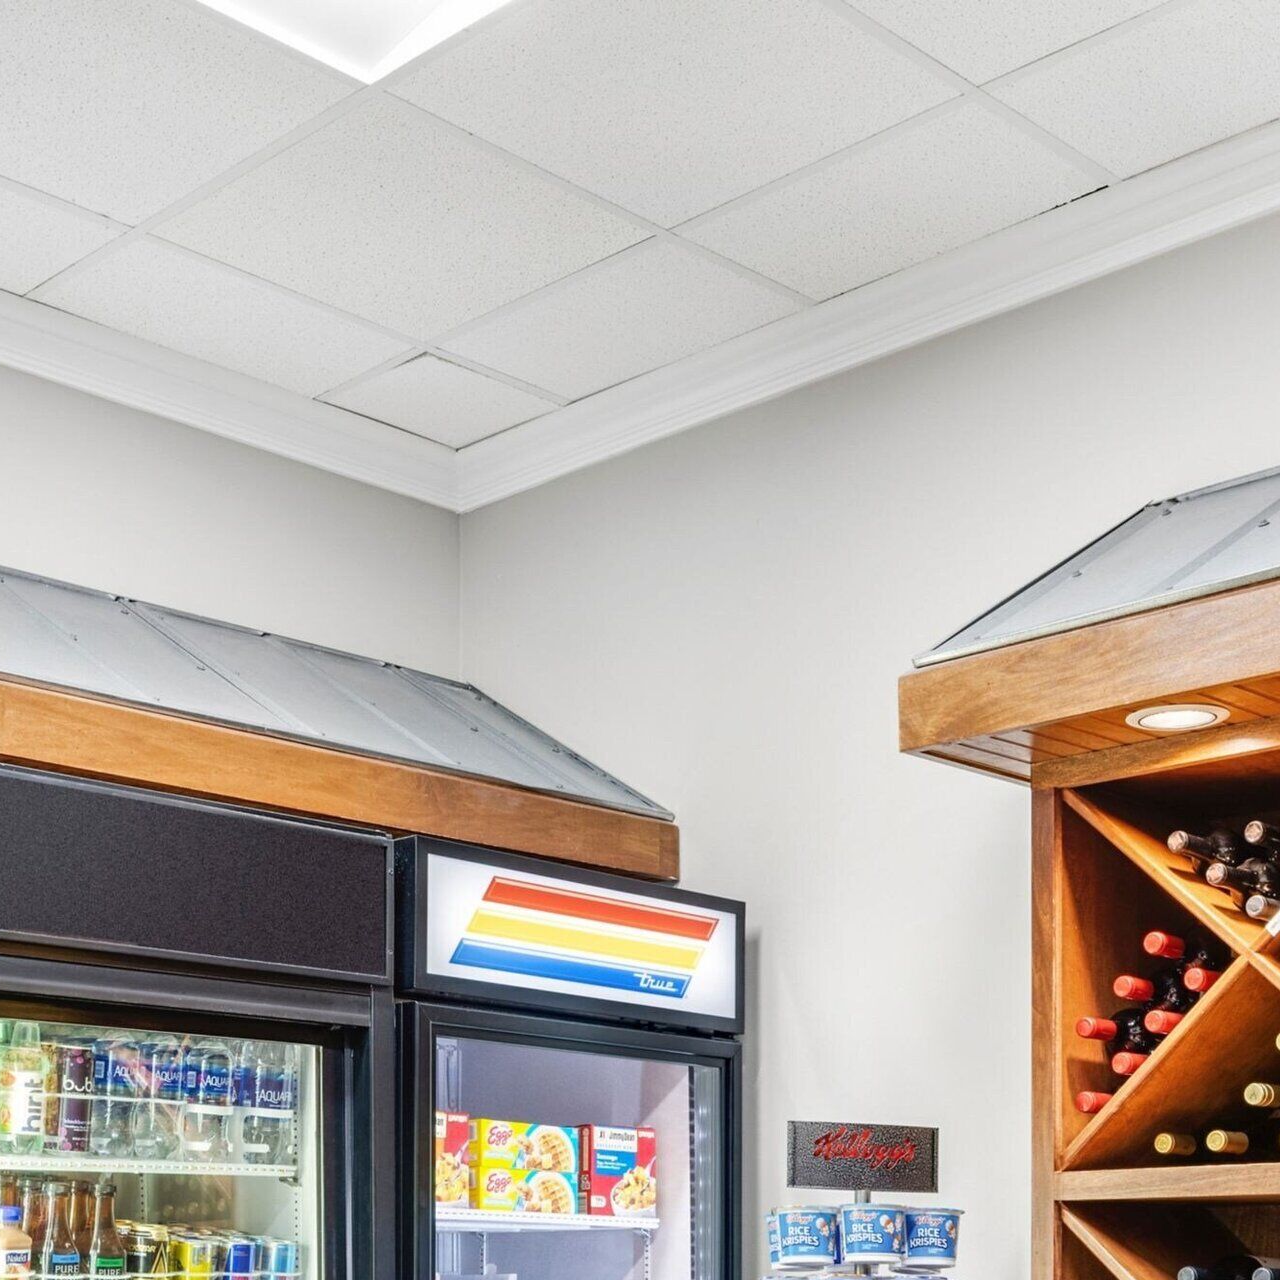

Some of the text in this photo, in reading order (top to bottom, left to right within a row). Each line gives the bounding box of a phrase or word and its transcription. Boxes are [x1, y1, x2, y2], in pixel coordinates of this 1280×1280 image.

[633, 972, 679, 993] true
[22, 1078, 43, 1132] hint
[488, 1126, 513, 1146] Eggo
[813, 1125, 918, 1170] Kellogg's
[486, 1173, 512, 1193] Eggo
[788, 1226, 810, 1236] RICE
[851, 1224, 873, 1233] RICE
[917, 1227, 939, 1237] RICE
[782, 1236, 819, 1247] KRISPIES
[847, 1233, 883, 1244] KRISPIES
[910, 1237, 947, 1248] KRISPIES
[6, 1253, 27, 1264] Naked
[55, 1264, 79, 1274] PURE
[98, 1269, 120, 1277] PURE
